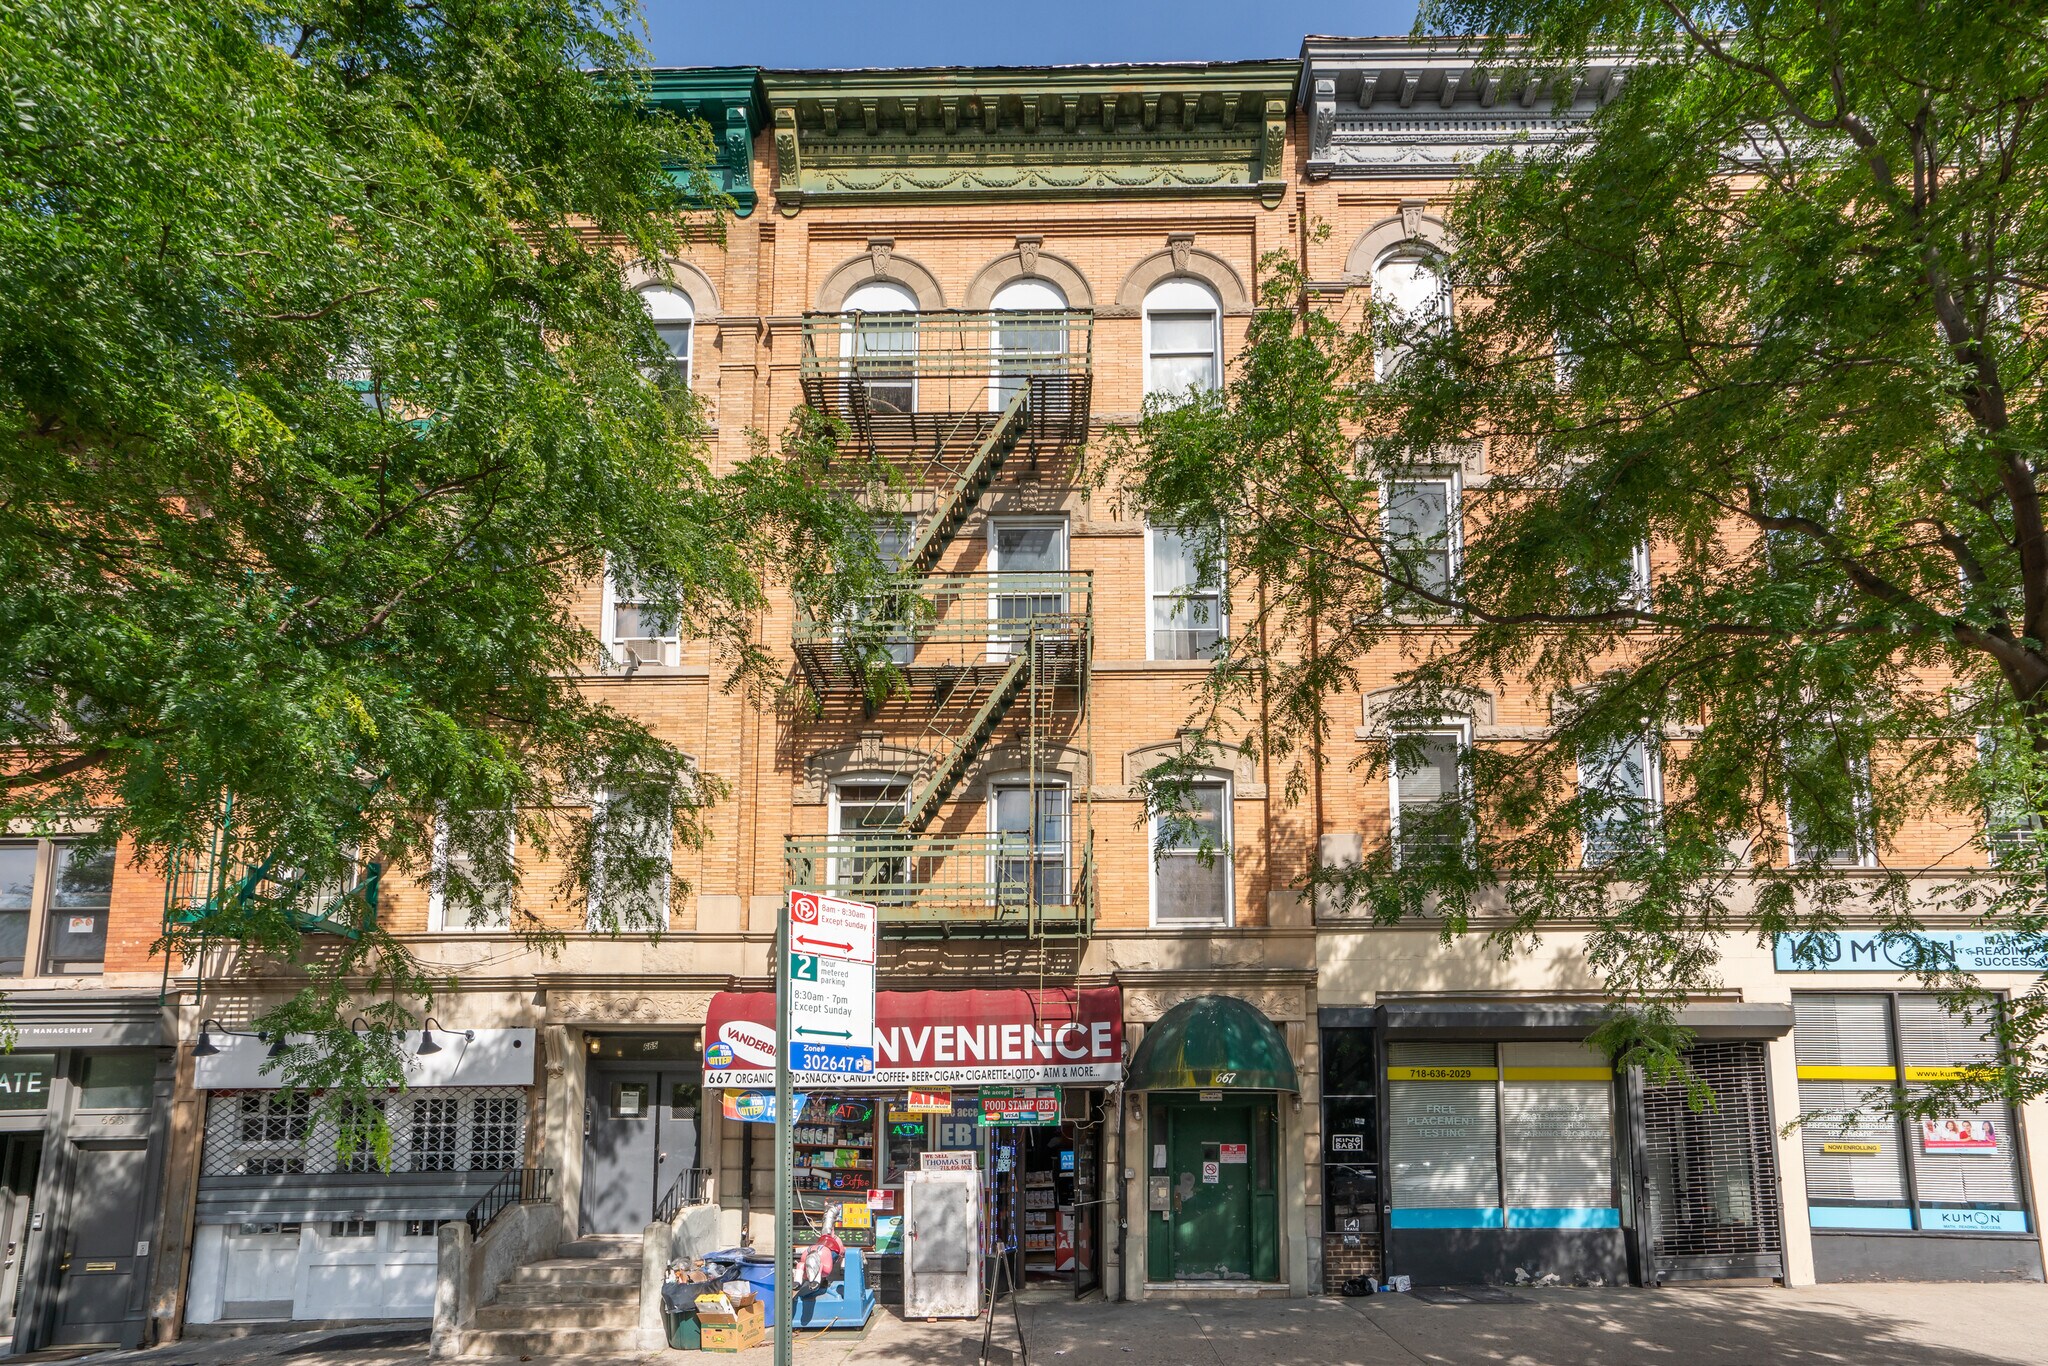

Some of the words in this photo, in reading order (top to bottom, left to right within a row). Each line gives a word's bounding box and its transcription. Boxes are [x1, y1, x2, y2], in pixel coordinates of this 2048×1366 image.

[821, 904, 836, 914] 8am
[842, 907, 866, 919] 8:30am
[821, 915, 843, 928] Except
[844, 918, 867, 931] Sunday
[797, 955, 811, 979] 2
[821, 960, 836, 968] hour
[821, 968, 849, 978] metered
[821, 977, 845, 987] parking
[794, 990, 824, 1002] 8:30am
[832, 994, 848, 1005] 7pm
[794, 1001, 822, 1013] Except
[824, 1004, 852, 1017] Sunday
[727, 1027, 776, 1056] VANDERBI
[803, 1044, 826, 1053] Zone#
[875, 1021, 1112, 1062] NVENIENCE
[803, 1054, 854, 1072] 302647
[709, 1072, 732, 1083] 667
[735, 1073, 773, 1083] ORGANIC
[805, 1073, 836, 1083] SNACKS
[876, 1071, 905, 1083] COFFEE
[911, 1070, 930, 1082] BEER
[934, 1069, 960, 1081] CIGAR
[965, 1068, 1007, 1080] CIGARETTE
[1011, 1067, 1036, 1080] LOTTO
[1043, 1066, 1060, 1078] ATM
[1062, 1067, 1067, 1077] &
[1215, 1073, 1236, 1084] 667
[1410, 1069, 1471, 1078] 718-636-2029
[909, 1091, 950, 1105] ATM
[984, 1101, 1006, 1111] FOOD
[1008, 1100, 1034, 1110] STAMP
[1036, 1100, 1058, 1112] (EBT)
[1426, 1105, 1456, 1113] FREE
[1407, 1117, 1476, 1125] PLACEMENT
[892, 1124, 925, 1134] ATM
[841, 1174, 870, 1189] Coffee
[1942, 1211, 2000, 1225] KUMON
